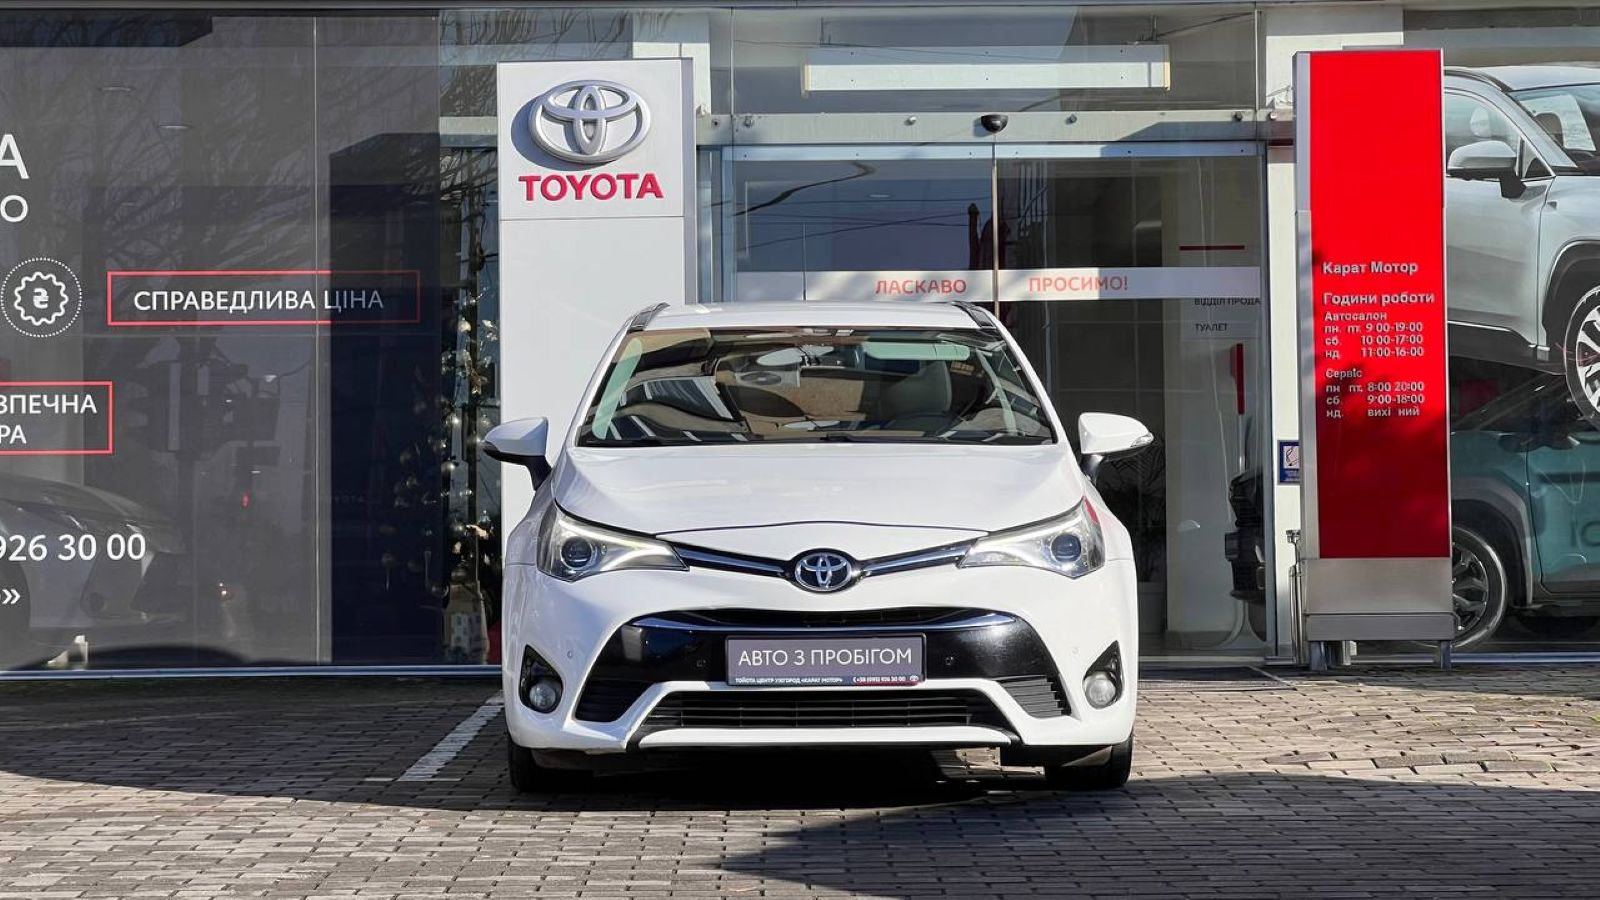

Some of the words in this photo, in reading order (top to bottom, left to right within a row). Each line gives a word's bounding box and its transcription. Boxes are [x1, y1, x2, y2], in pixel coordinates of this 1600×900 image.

[518, 173, 664, 201] TOYOTA
[1322, 262, 1366, 276] Карат
[1370, 261, 1418, 276] Мотор
[875, 279, 967, 295] ЛАСКАВО
[1028, 276, 1129, 292] ПРОСИМО!
[134, 290, 315, 314] СПРАВЕДЛИВА
[324, 289, 384, 312] ЦІНА
[1323, 292, 1377, 306] Години
[1381, 291, 1435, 306] роботи
[1324, 310, 1387, 321] Автосалон
[1195, 323, 1228, 332] ТУАЛЕТ
[1325, 367, 1363, 380] Сервіс
[58, 534, 97, 561] 30
[107, 534, 146, 561] 00
[738, 650, 788, 666] АВТО
[811, 648, 912, 666] ПРОБІГОМ
